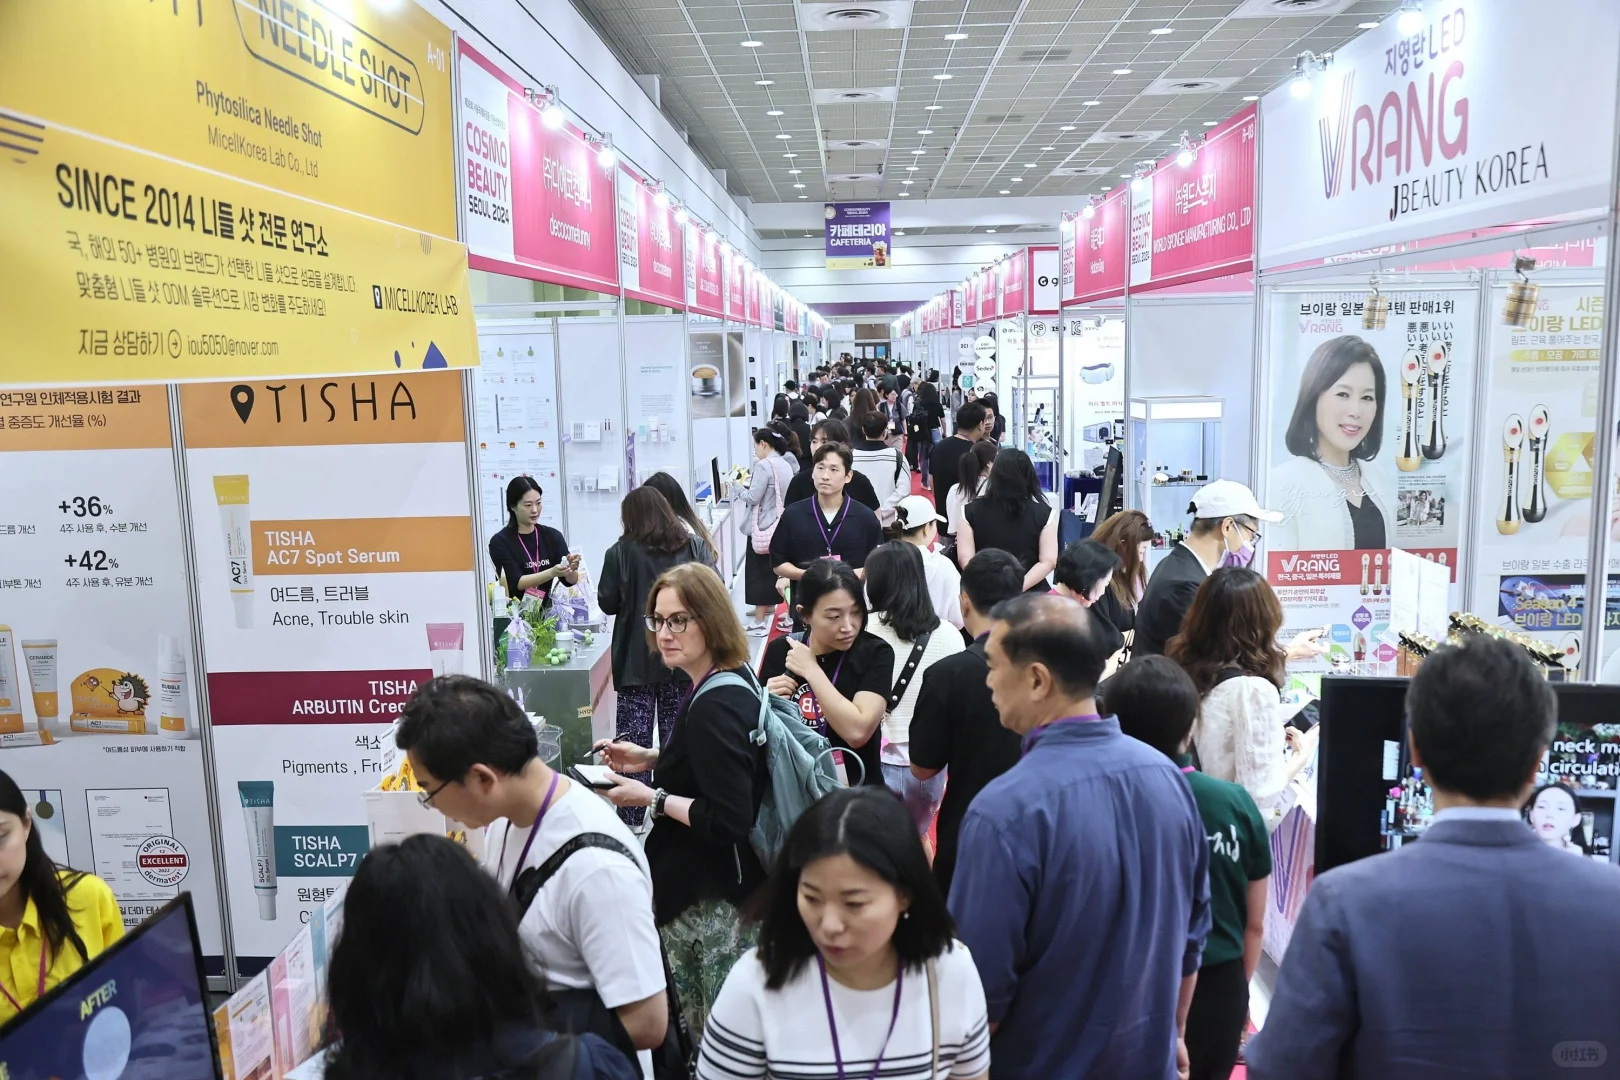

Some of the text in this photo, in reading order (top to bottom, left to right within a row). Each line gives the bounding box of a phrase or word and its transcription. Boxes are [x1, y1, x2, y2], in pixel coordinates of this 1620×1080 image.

[259, 0, 356, 86] NEEDLE
[360, 49, 411, 114] SHOT
[427, 42, 446, 73] A-01
[197, 79, 323, 149] Phytosilica Needle Shot
[1318, 60, 1469, 199] VRANG
[208, 125, 319, 179] MicellKorea Lab Co., Ltd
[466, 121, 508, 169] COSMO
[1474, 141, 1549, 196] KOREA
[467, 160, 508, 202] BEAUTY
[56, 163, 329, 258] SINCE 2014 니들 샷 전문 연구소
[468, 194, 510, 225] SEOUL 2024
[829, 223, 887, 237] 카페테리아
[1152, 237, 1168, 254] WORLD
[1167, 229, 1185, 251] SPONGE
[1184, 215, 1226, 247] MANUFACTURING
[1240, 206, 1252, 227] LTD
[88, 233, 118, 262] 해외
[118, 240, 143, 265] 50+
[830, 238, 872, 247] CAFETERIA
[76, 271, 119, 300] 맞춤형
[119, 276, 147, 303] 니들
[148, 280, 162, 304] 샷
[162, 281, 190, 306] ODM
[191, 286, 241, 311] 솔루션으로
[385, 285, 459, 316] MICELLKOREA LAB
[1300, 302, 1337, 316] 브이랑
[1340, 301, 1364, 316] 일본
[1299, 321, 1343, 333] VRANG
[1569, 316, 1603, 331] LED
[78, 328, 164, 357] 지금 상담하기
[1547, 350, 1563, 360] 모공
[1571, 350, 1587, 360] 기미
[1, 389, 142, 406] 연구원 인체적용시험 결과
[265, 381, 417, 424] TISHA
[8, 414, 107, 429] 중증도 개선율 (%)
[58, 495, 114, 518] +36%
[18, 524, 36, 535] 개선
[60, 521, 148, 535] 4주 사용 후, 수분 개선
[264, 530, 316, 547] TISHA
[64, 549, 119, 571] +42%
[267, 548, 401, 567] AC7 Spot Serum
[1280, 554, 1340, 573] VRANG
[1502, 559, 1571, 571] 브이랑 일본 수출
[232, 560, 242, 585] AC7
[24, 578, 42, 589] 개선
[65, 576, 154, 588] 4주 사용 후, 유분 개선
[270, 585, 370, 604] 여드름, 트러블
[1515, 596, 1578, 611] Season 4
[272, 609, 410, 628] Acne, Trouble skin
[1514, 612, 1583, 628] 브이랑 LED
[368, 680, 418, 696] TISHA
[292, 699, 365, 715] ARBUTIN
[1553, 738, 1596, 754] neck
[282, 758, 349, 777] Pigments
[142, 838, 180, 853] ORIGINAL
[292, 836, 341, 850] TISHA
[142, 857, 184, 865] EXCELLENT
[293, 853, 357, 868] SCALP7
[144, 869, 183, 884] dermatest
[128, 905, 145, 915] 더마
[80, 979, 118, 1021] AFTER
